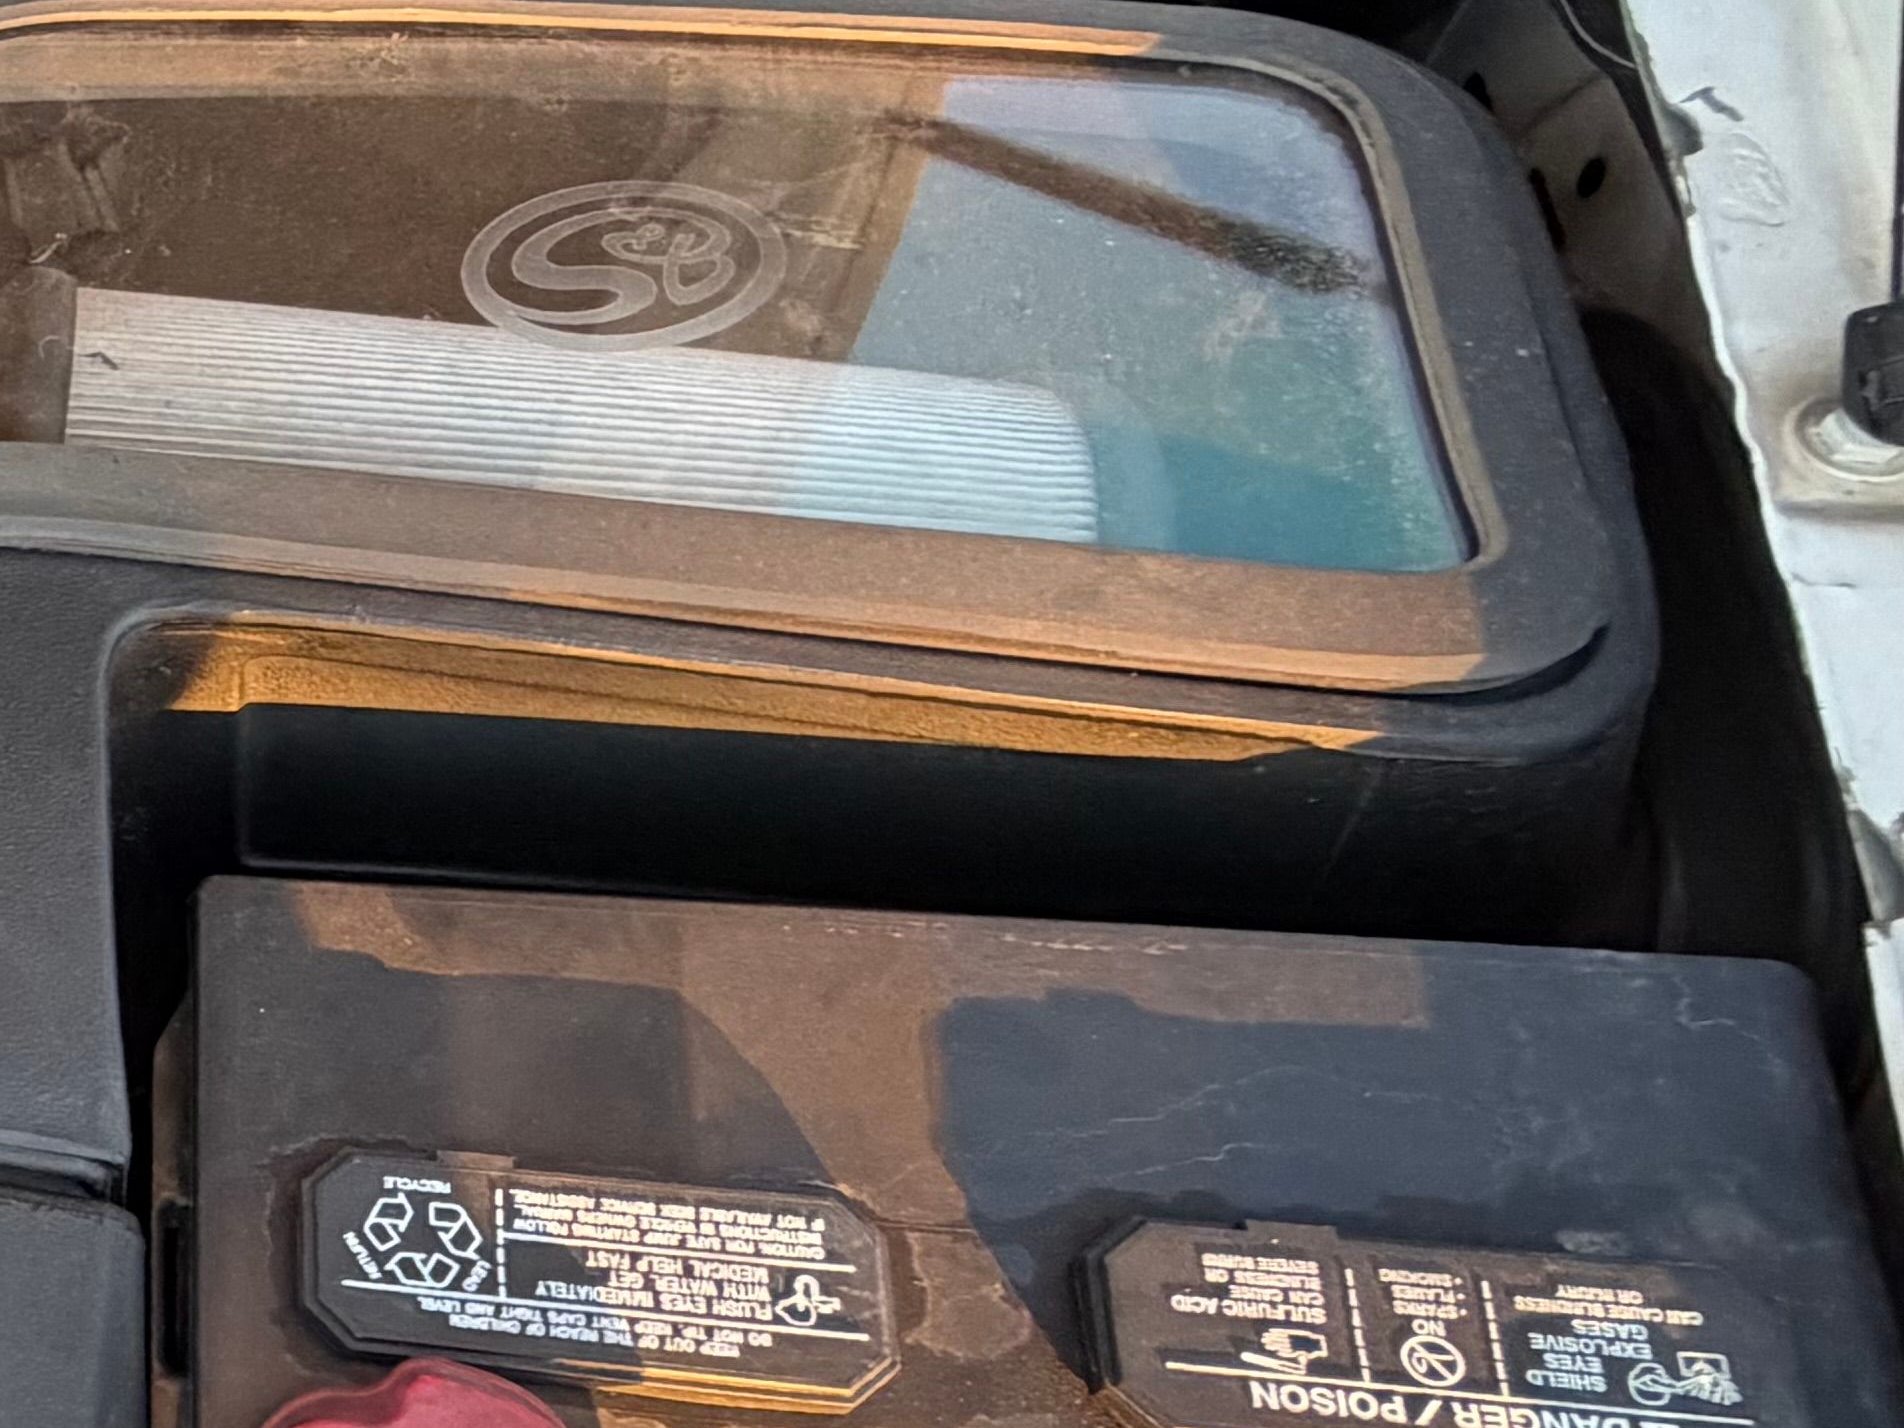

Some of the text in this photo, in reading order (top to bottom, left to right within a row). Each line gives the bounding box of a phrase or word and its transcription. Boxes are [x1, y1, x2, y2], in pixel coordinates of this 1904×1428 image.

[382, 1174, 452, 1194] RECYCLE
[584, 1249, 770, 1284] MEDICAL HELP FAST
[1203, 1267, 1229, 1282] OR
[606, 1270, 644, 1289] GET
[534, 1279, 773, 1320] FLUSH EYES IMMEDIATELY
[719, 1281, 772, 1302] WITH
[1227, 1284, 1324, 1305] CAN CAUSE
[1618, 1289, 1644, 1304] OR
[463, 1302, 495, 1317] AND
[499, 1305, 542, 1321] TIGHT
[545, 1310, 586, 1326] CAPS
[1169, 1293, 1327, 1324] SULFURIC ACID
[1512, 1295, 1703, 1326] CAN CAUSE BLINDNESS
[590, 1314, 631, 1331] VENT
[633, 1319, 673, 1336] KEEP
[1410, 1318, 1447, 1336] NO
[1569, 1318, 1649, 1339] GASES
[447, 1312, 740, 1358] KEEP OUT OF THE REACH OF CHILDREN
[713, 1328, 744, 1343] NOT
[747, 1331, 773, 1347] DO
[1525, 1331, 1653, 1359] EXPLOSIVE
[1541, 1351, 1604, 1372] EYES
[1524, 1368, 1608, 1391] SHIELD
[1246, 1379, 1408, 1423] POISON
